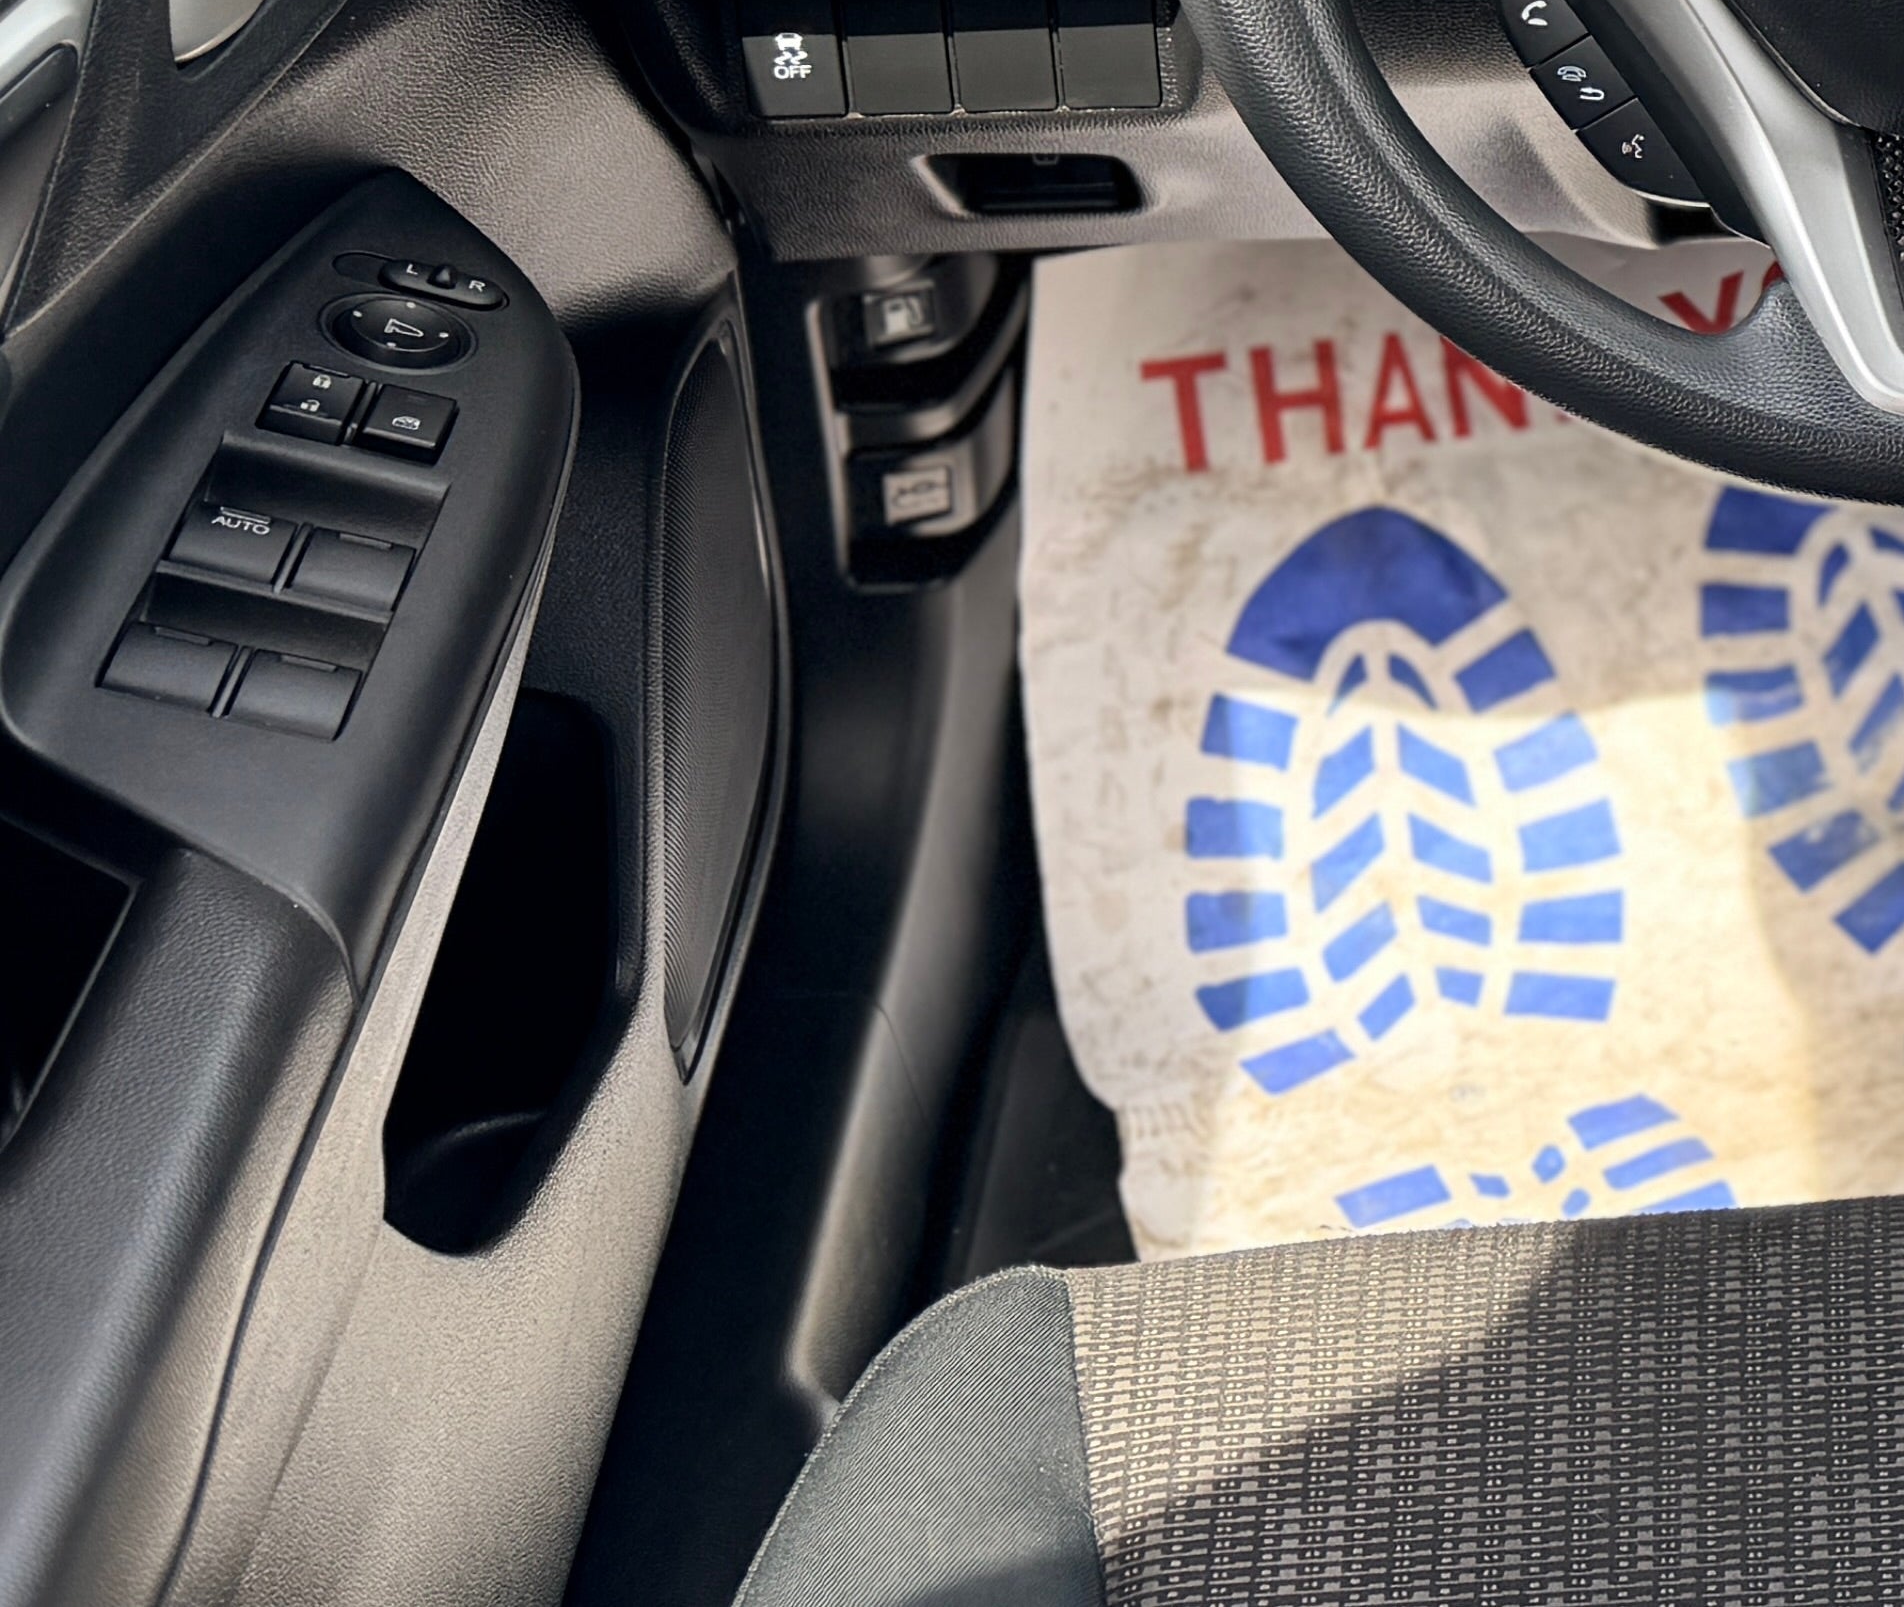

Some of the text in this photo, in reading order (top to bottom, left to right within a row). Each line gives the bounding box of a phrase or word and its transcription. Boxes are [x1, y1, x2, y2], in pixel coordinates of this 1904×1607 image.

[774, 64, 811, 80] OFF
[406, 262, 419, 276] L
[469, 278, 486, 292] R
[1141, 331, 1574, 472] THAN
[211, 515, 271, 535] AUTO
